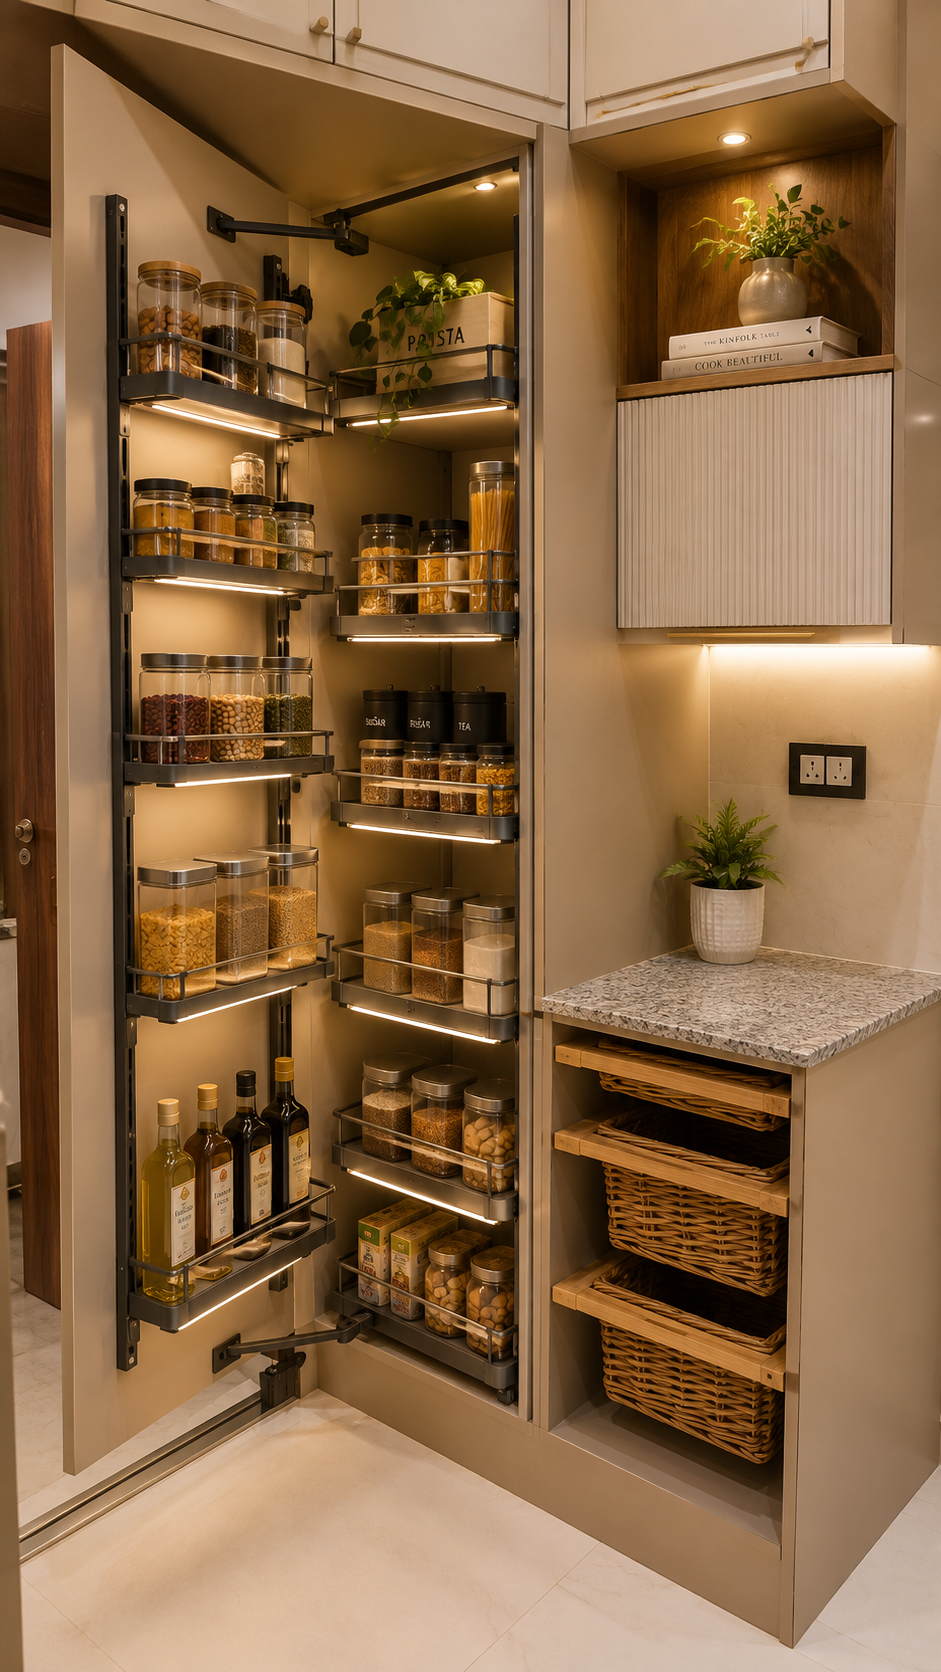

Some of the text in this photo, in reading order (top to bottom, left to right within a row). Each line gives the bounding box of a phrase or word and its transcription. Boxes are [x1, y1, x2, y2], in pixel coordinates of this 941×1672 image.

[719, 333, 758, 345] KINFOLK
[694, 360, 723, 371] COOK
[726, 352, 783, 367] BEAUTIFUL
[458, 722, 472, 731] TEA
